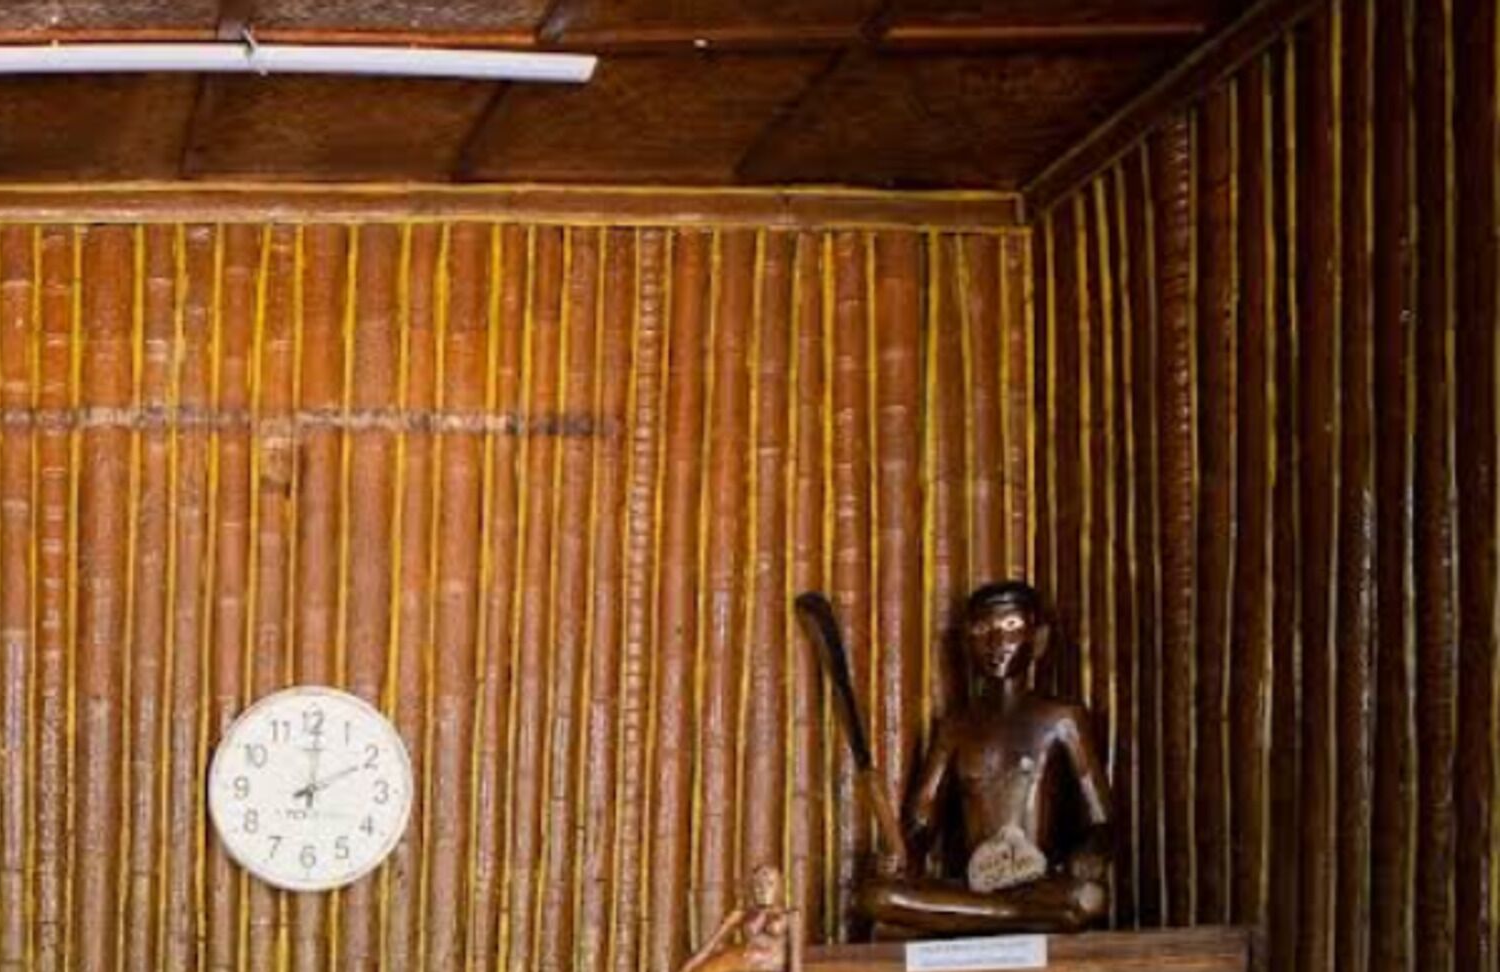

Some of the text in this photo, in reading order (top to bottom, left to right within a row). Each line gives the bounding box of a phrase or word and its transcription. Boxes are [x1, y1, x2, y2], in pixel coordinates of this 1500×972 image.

[271, 720, 290, 742] 11
[302, 709, 325, 735] 12
[344, 721, 350, 745] 1
[244, 744, 268, 768] 10
[364, 744, 379, 770] 2
[234, 776, 249, 799] 9
[374, 780, 389, 804] 3
[244, 809, 259, 833] 8
[359, 816, 373, 837] 4
[268, 835, 282, 859] 7
[299, 845, 316, 868] 6
[335, 836, 349, 860] 5
